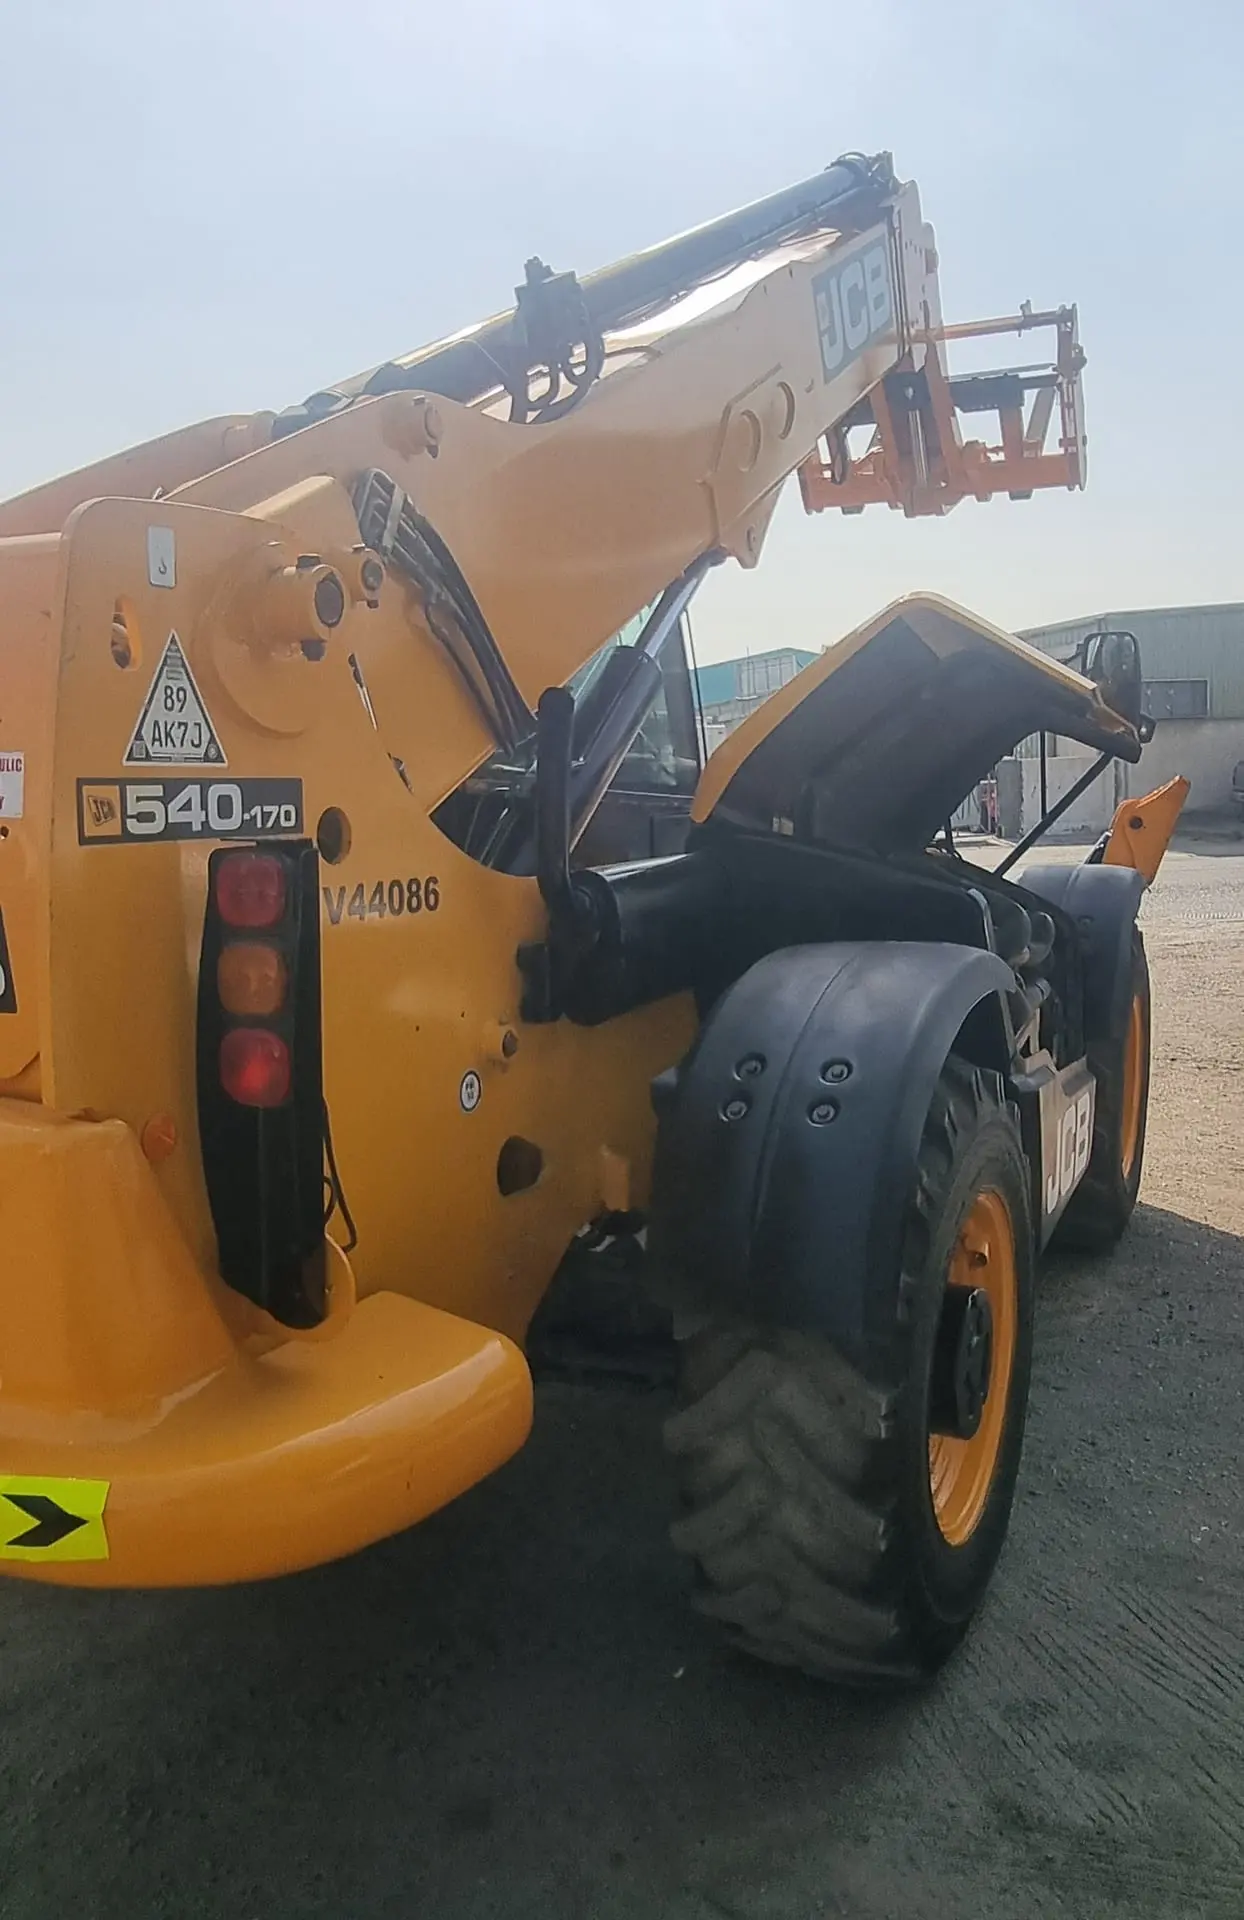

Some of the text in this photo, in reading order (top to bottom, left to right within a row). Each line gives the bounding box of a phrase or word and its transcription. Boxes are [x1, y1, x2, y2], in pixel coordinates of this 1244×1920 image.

[820, 245, 891, 370] JCB
[164, 685, 187, 713] 89
[151, 720, 202, 749] AK7J
[322, 876, 440, 925] V44086
[1047, 1093, 1090, 1214] JCB
